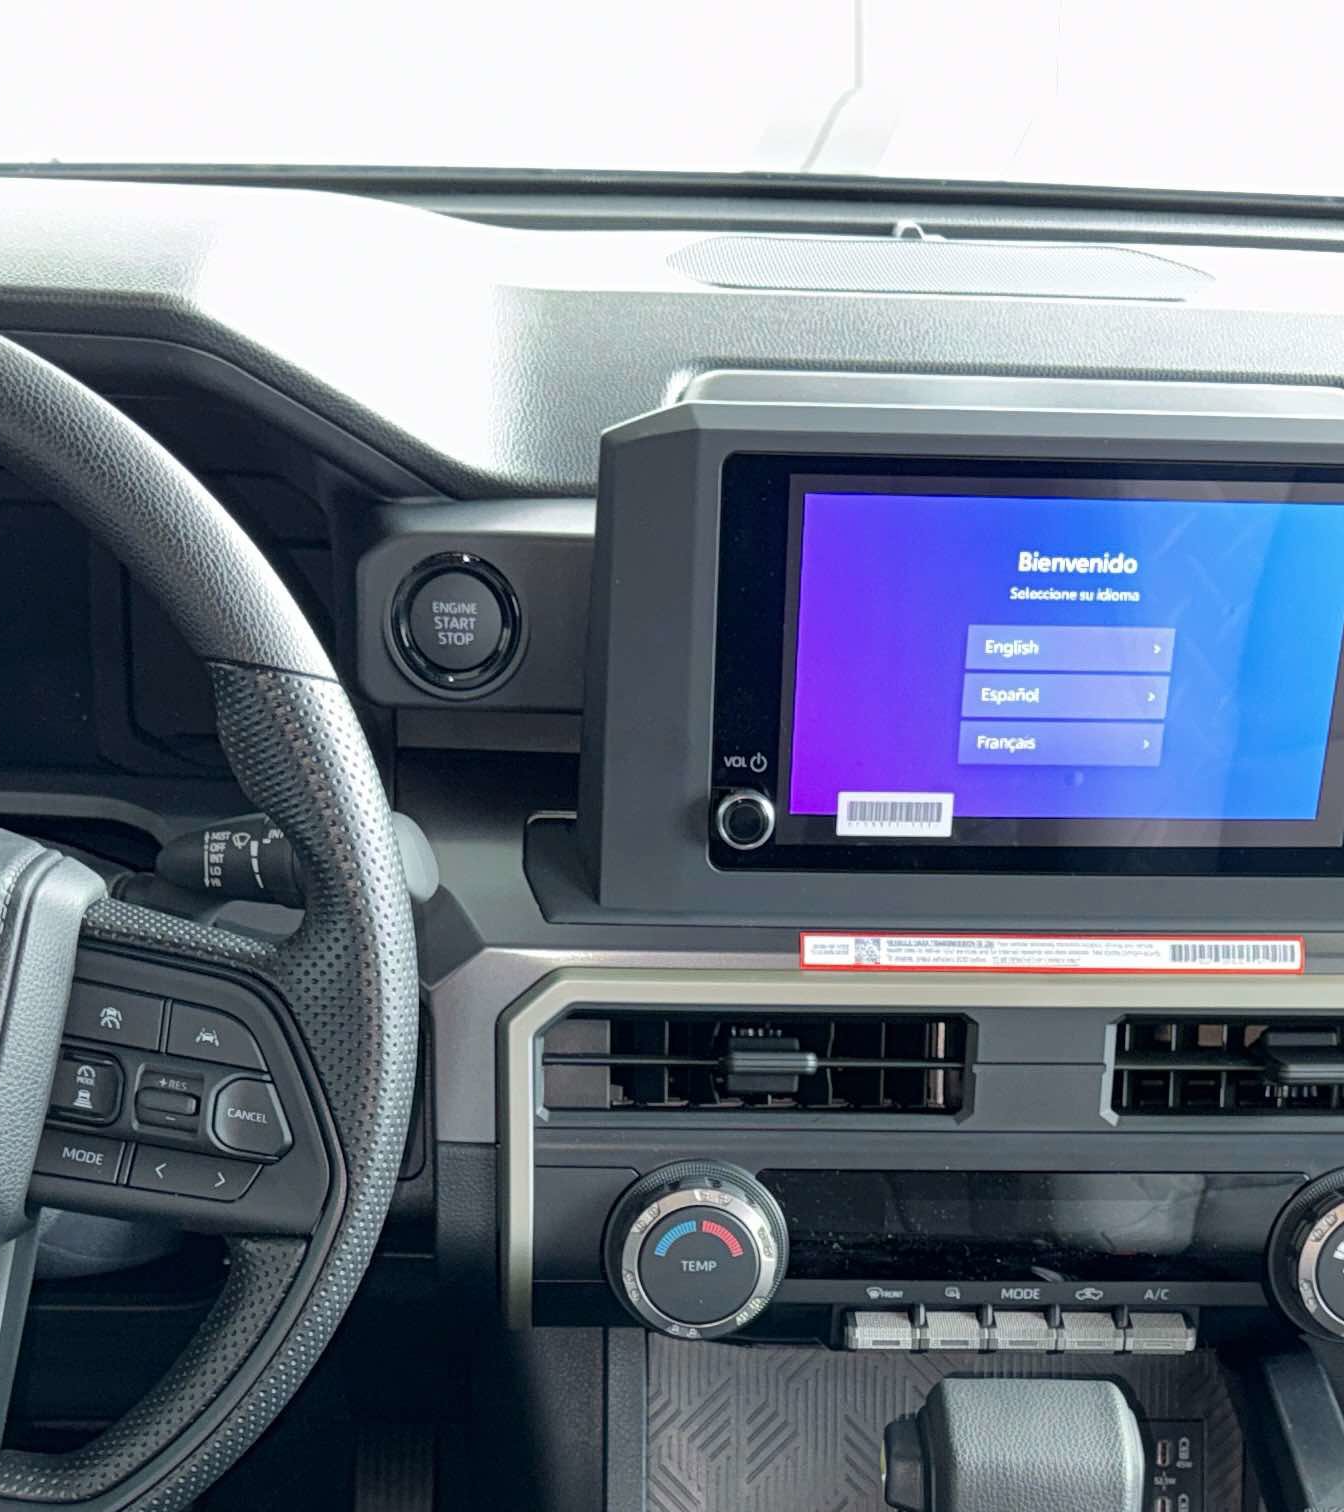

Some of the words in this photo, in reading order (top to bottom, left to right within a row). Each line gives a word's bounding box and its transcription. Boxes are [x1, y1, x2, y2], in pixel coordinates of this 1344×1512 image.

[1018, 551, 1138, 574] Bienvenido
[1009, 586, 1077, 601] Seleccione
[1079, 591, 1094, 601] su
[1097, 588, 1141, 602] idioma
[432, 602, 478, 615] ENGINE
[434, 616, 476, 630] START
[438, 632, 474, 646] STOP
[984, 639, 1040, 658] English
[981, 687, 1040, 705] Español
[977, 735, 1036, 753] Français
[724, 756, 748, 768] VOL
[209, 842, 226, 853] OFF
[209, 866, 222, 876] LO
[227, 1107, 268, 1124] CANCEL
[62, 1147, 104, 1166] MODE
[681, 1260, 718, 1272] TEMP
[1001, 1288, 1041, 1300] MODE
[1143, 1288, 1169, 1301] A/C
